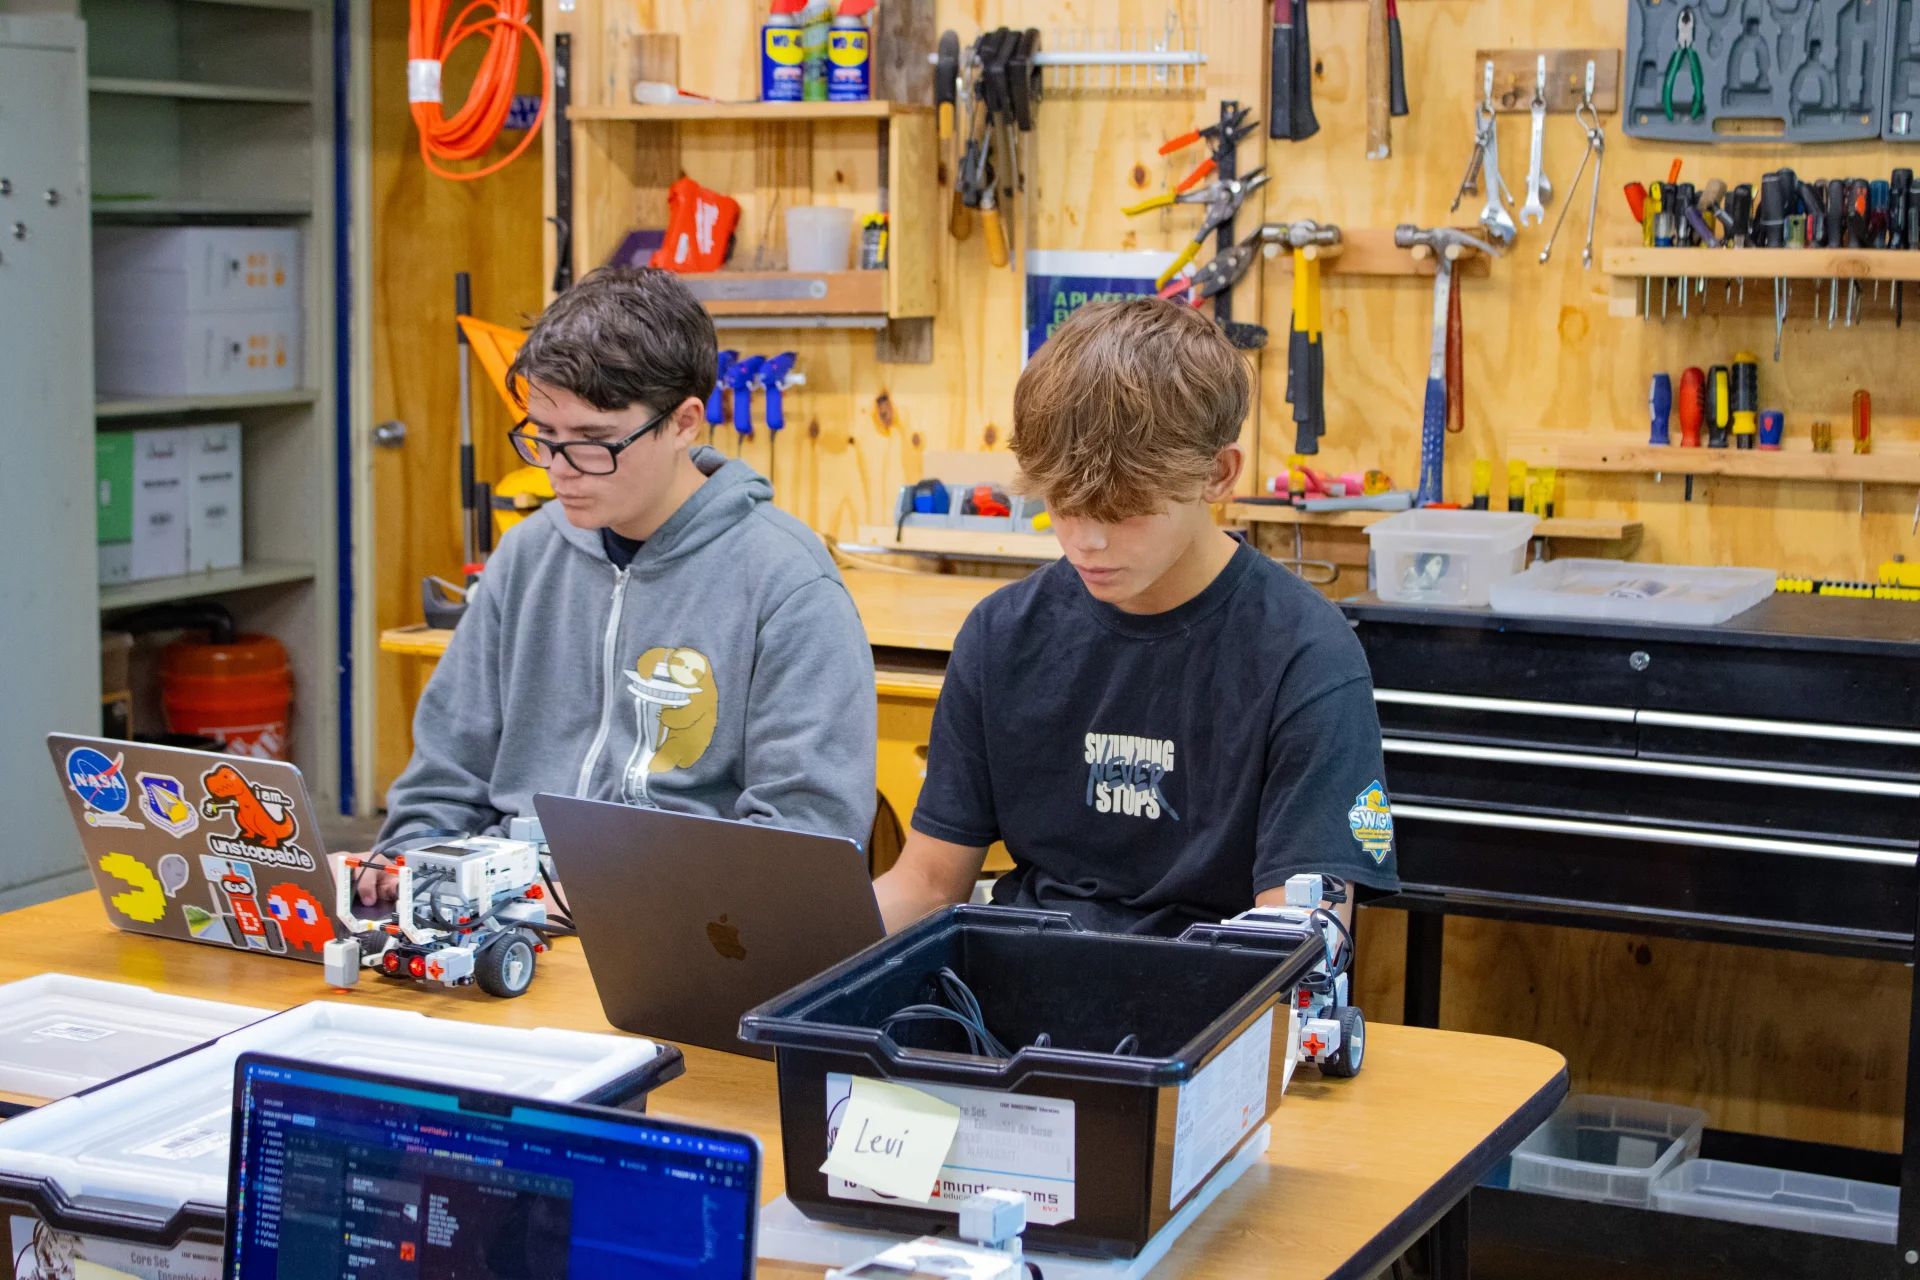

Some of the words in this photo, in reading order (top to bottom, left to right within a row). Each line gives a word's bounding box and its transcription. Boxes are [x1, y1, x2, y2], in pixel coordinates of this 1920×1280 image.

[1054, 291, 1067, 307] A
[1085, 732, 1175, 771] SWIMMING
[72, 772, 125, 790] NASA
[1086, 740, 1180, 821] NEVER
[1095, 781, 1161, 820] STOPS
[211, 838, 313, 868] unstoppable
[854, 1117, 910, 1159] Levi
[943, 1180, 1058, 1204] mindms
[130, 1251, 152, 1266] Core
[153, 1255, 170, 1269] Set
